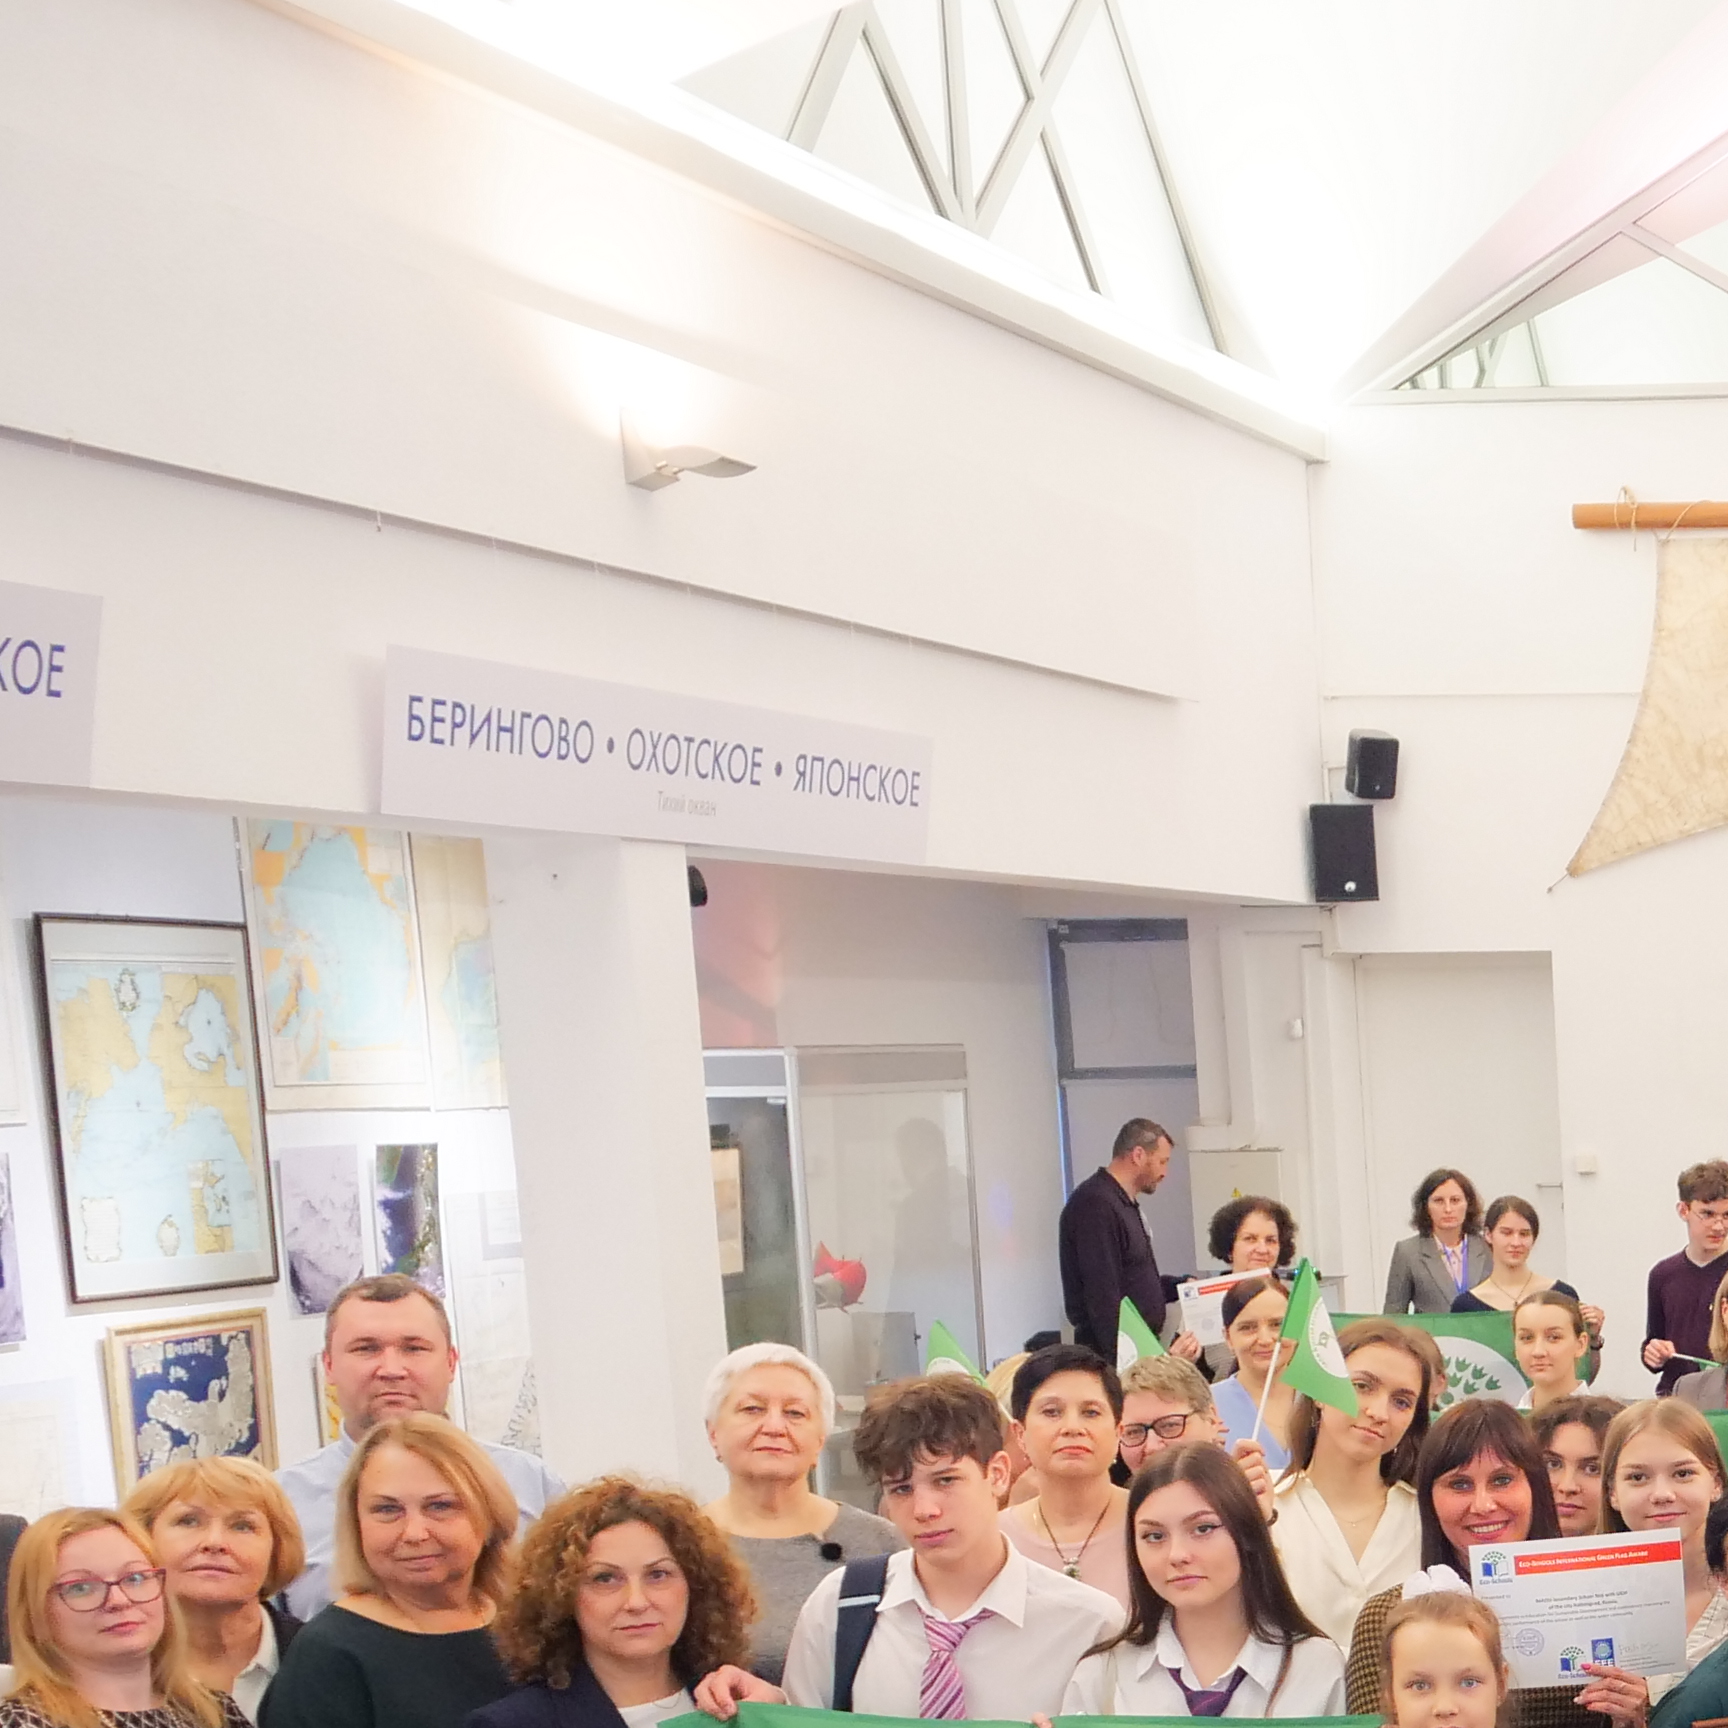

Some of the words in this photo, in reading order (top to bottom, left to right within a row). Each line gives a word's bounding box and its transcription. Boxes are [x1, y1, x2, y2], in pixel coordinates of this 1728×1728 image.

[406, 693, 595, 765] БЕРИНГОВО
[625, 726, 765, 786] ОХОТСКОЕ
[791, 752, 922, 807] ЯПОНСКОЕ
